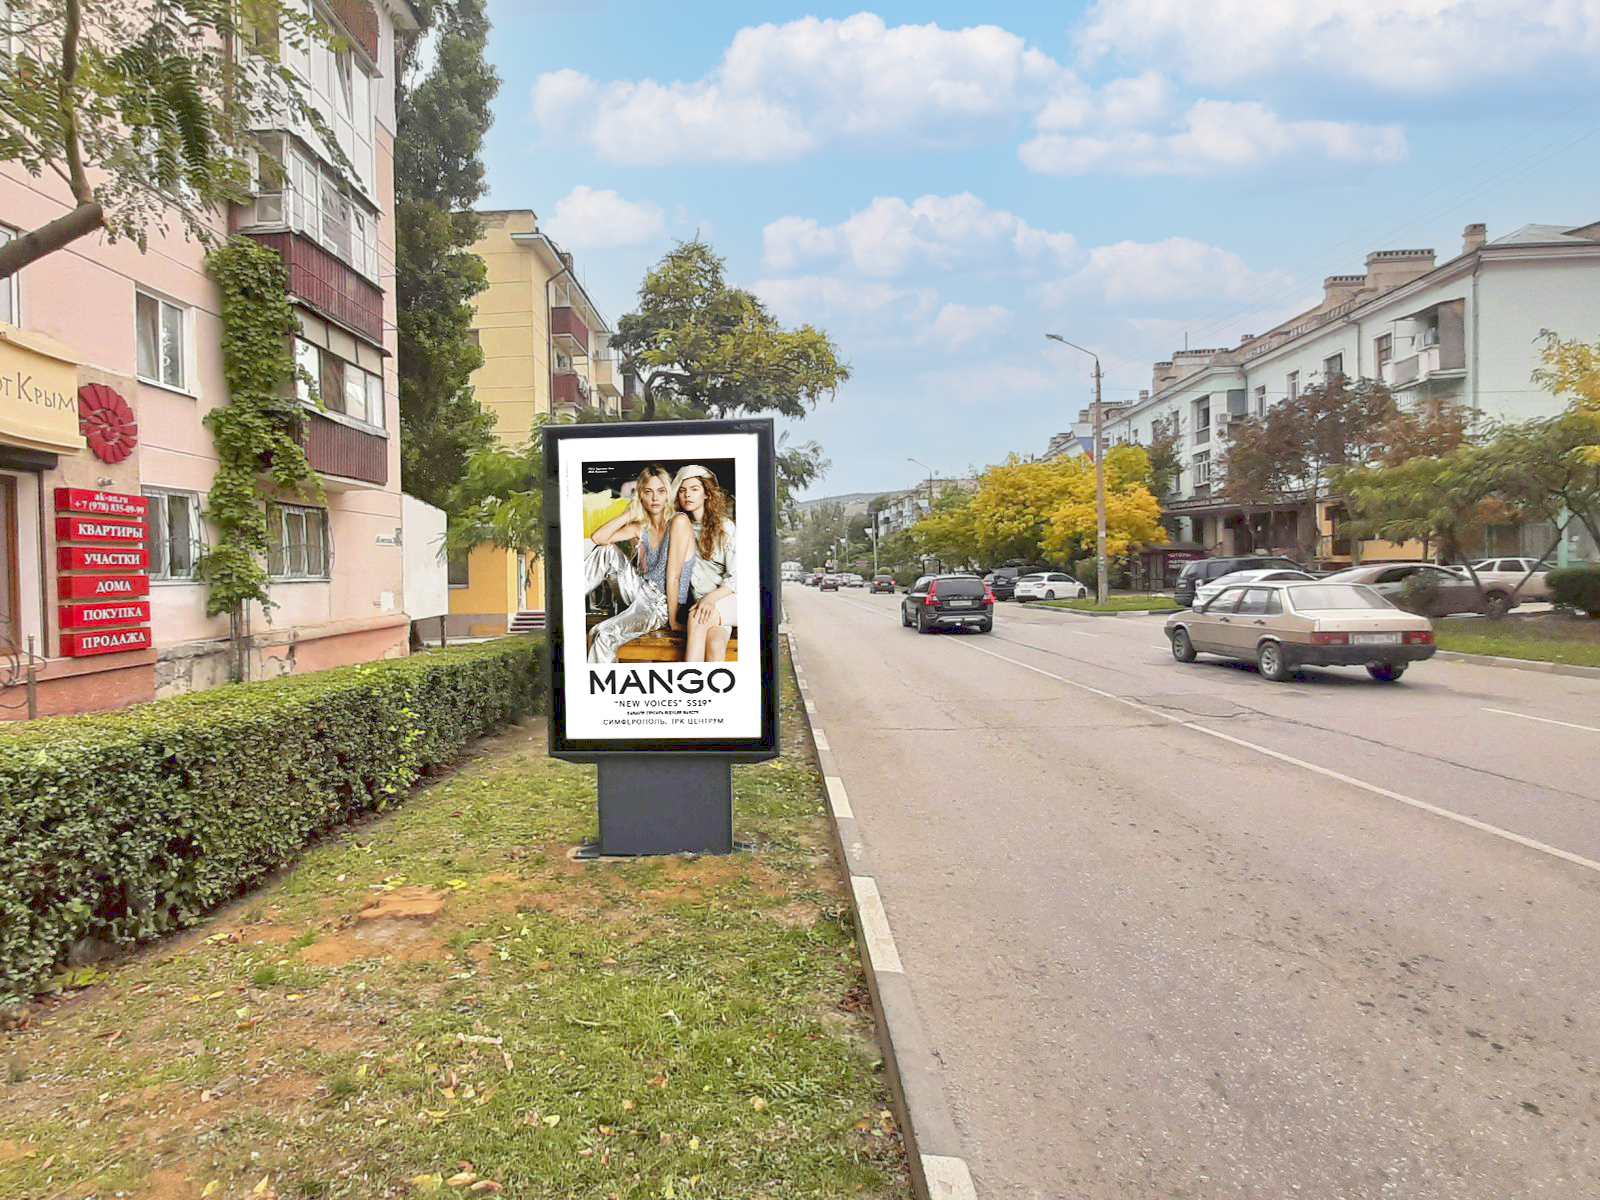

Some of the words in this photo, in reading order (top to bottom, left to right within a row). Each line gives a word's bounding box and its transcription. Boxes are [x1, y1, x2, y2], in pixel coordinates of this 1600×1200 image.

[88, 501, 109, 513] (978)
[78, 523, 143, 538] КВАРТИРЫ
[84, 553, 140, 565] УЧАСТКИ
[95, 580, 132, 594] ДОМА
[83, 606, 143, 621] ПОКУПКА
[82, 632, 146, 649] ПРОДАЖА
[589, 667, 736, 695] MANGO
